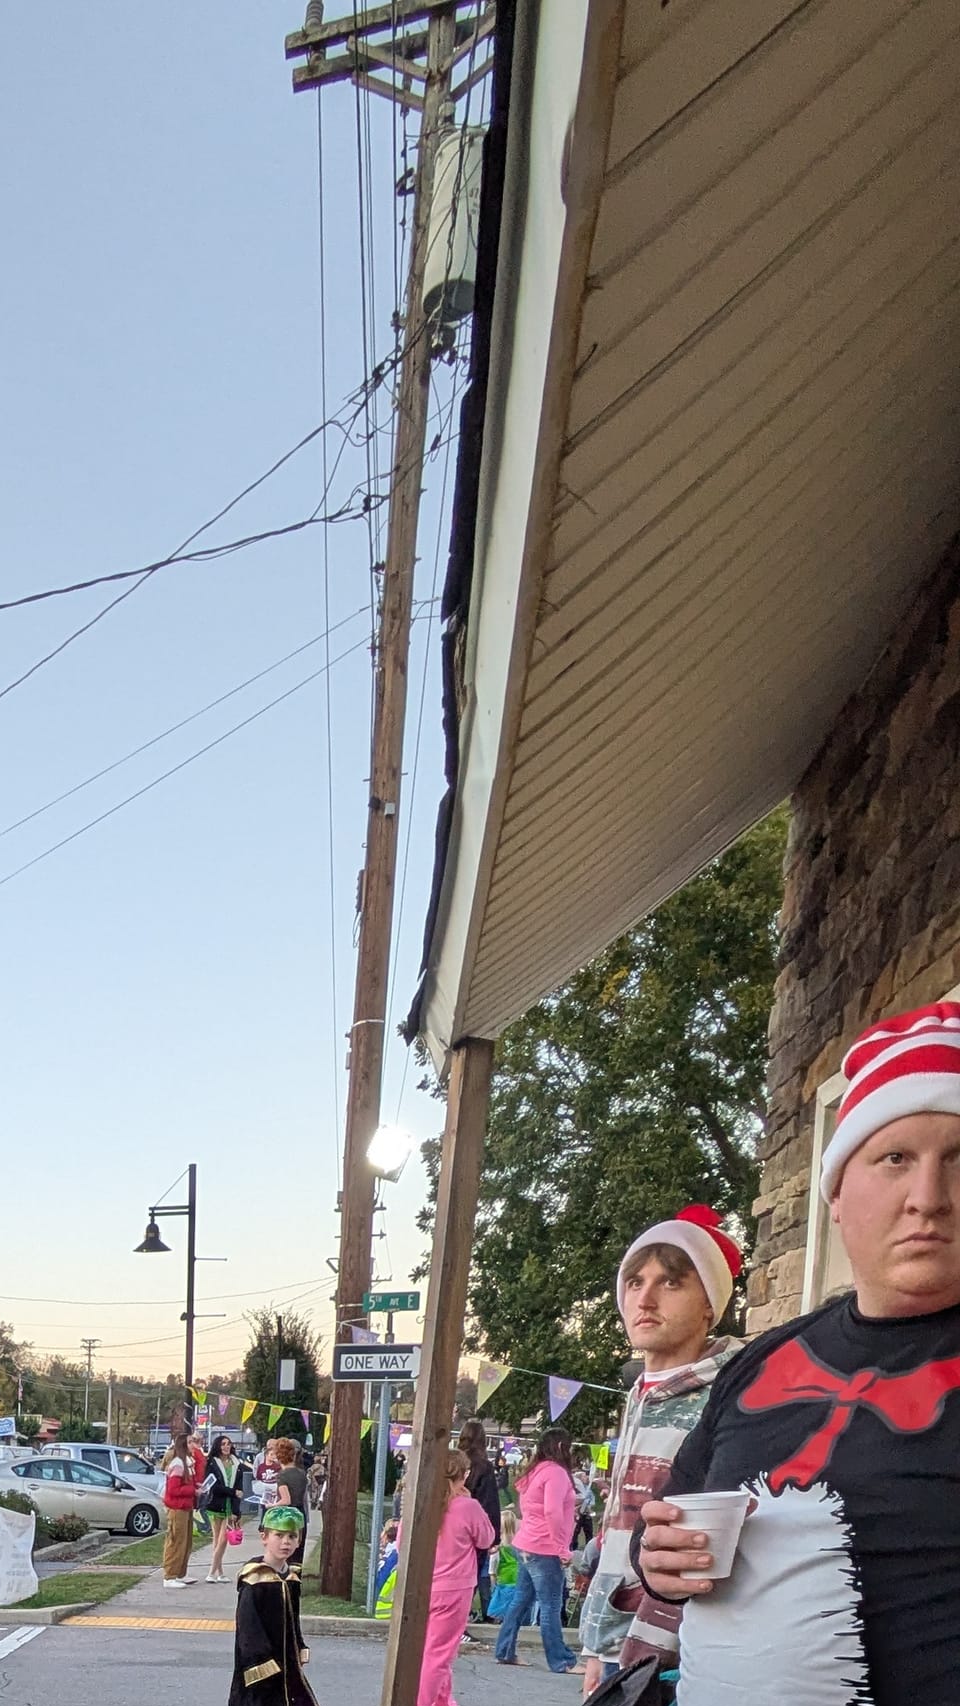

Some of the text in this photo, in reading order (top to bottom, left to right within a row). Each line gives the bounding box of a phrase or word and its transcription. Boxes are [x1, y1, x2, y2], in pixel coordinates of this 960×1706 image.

[407, 1294, 415, 1308] E
[345, 1356, 409, 1369] ONE WAY
